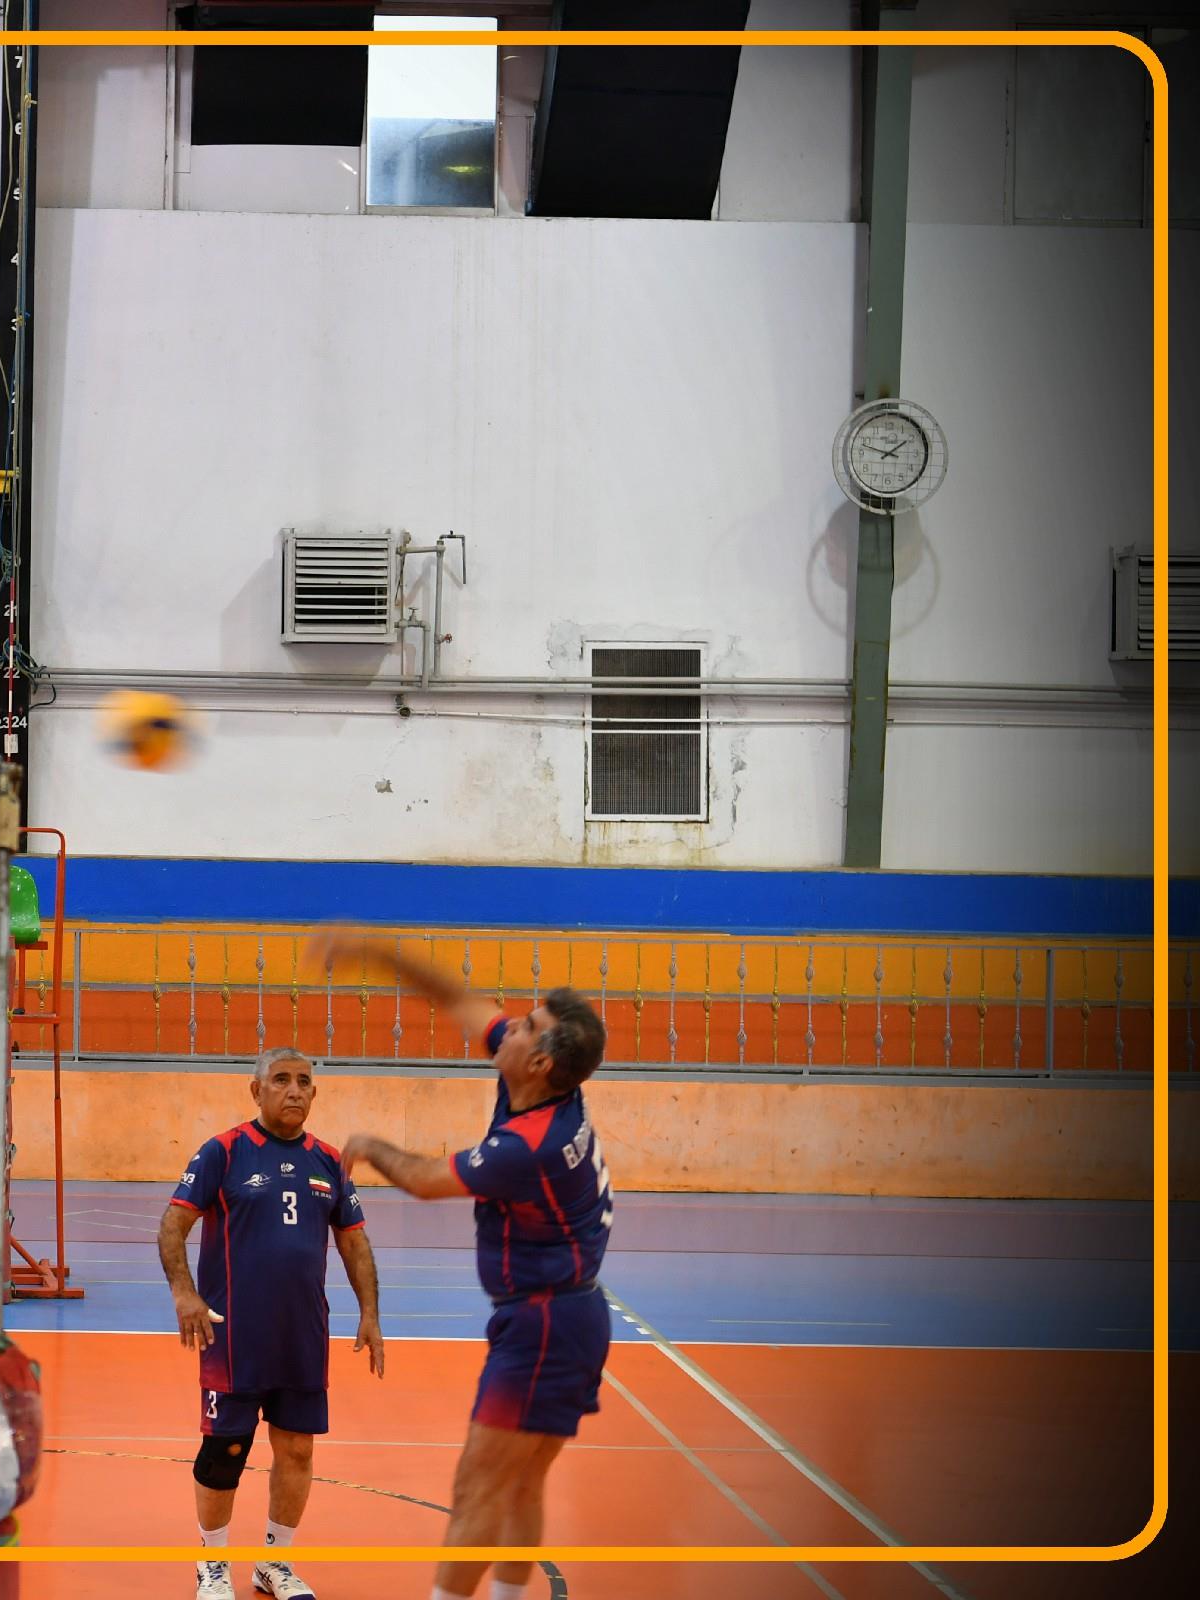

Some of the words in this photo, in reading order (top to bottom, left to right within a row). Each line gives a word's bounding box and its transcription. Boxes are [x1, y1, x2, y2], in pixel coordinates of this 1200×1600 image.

[14, 55, 23, 69] 7
[3, 666, 21, 679] 22
[11, 715, 28, 729] 24
[281, 1191, 298, 1225] 3
[205, 1390, 218, 1419] 3
